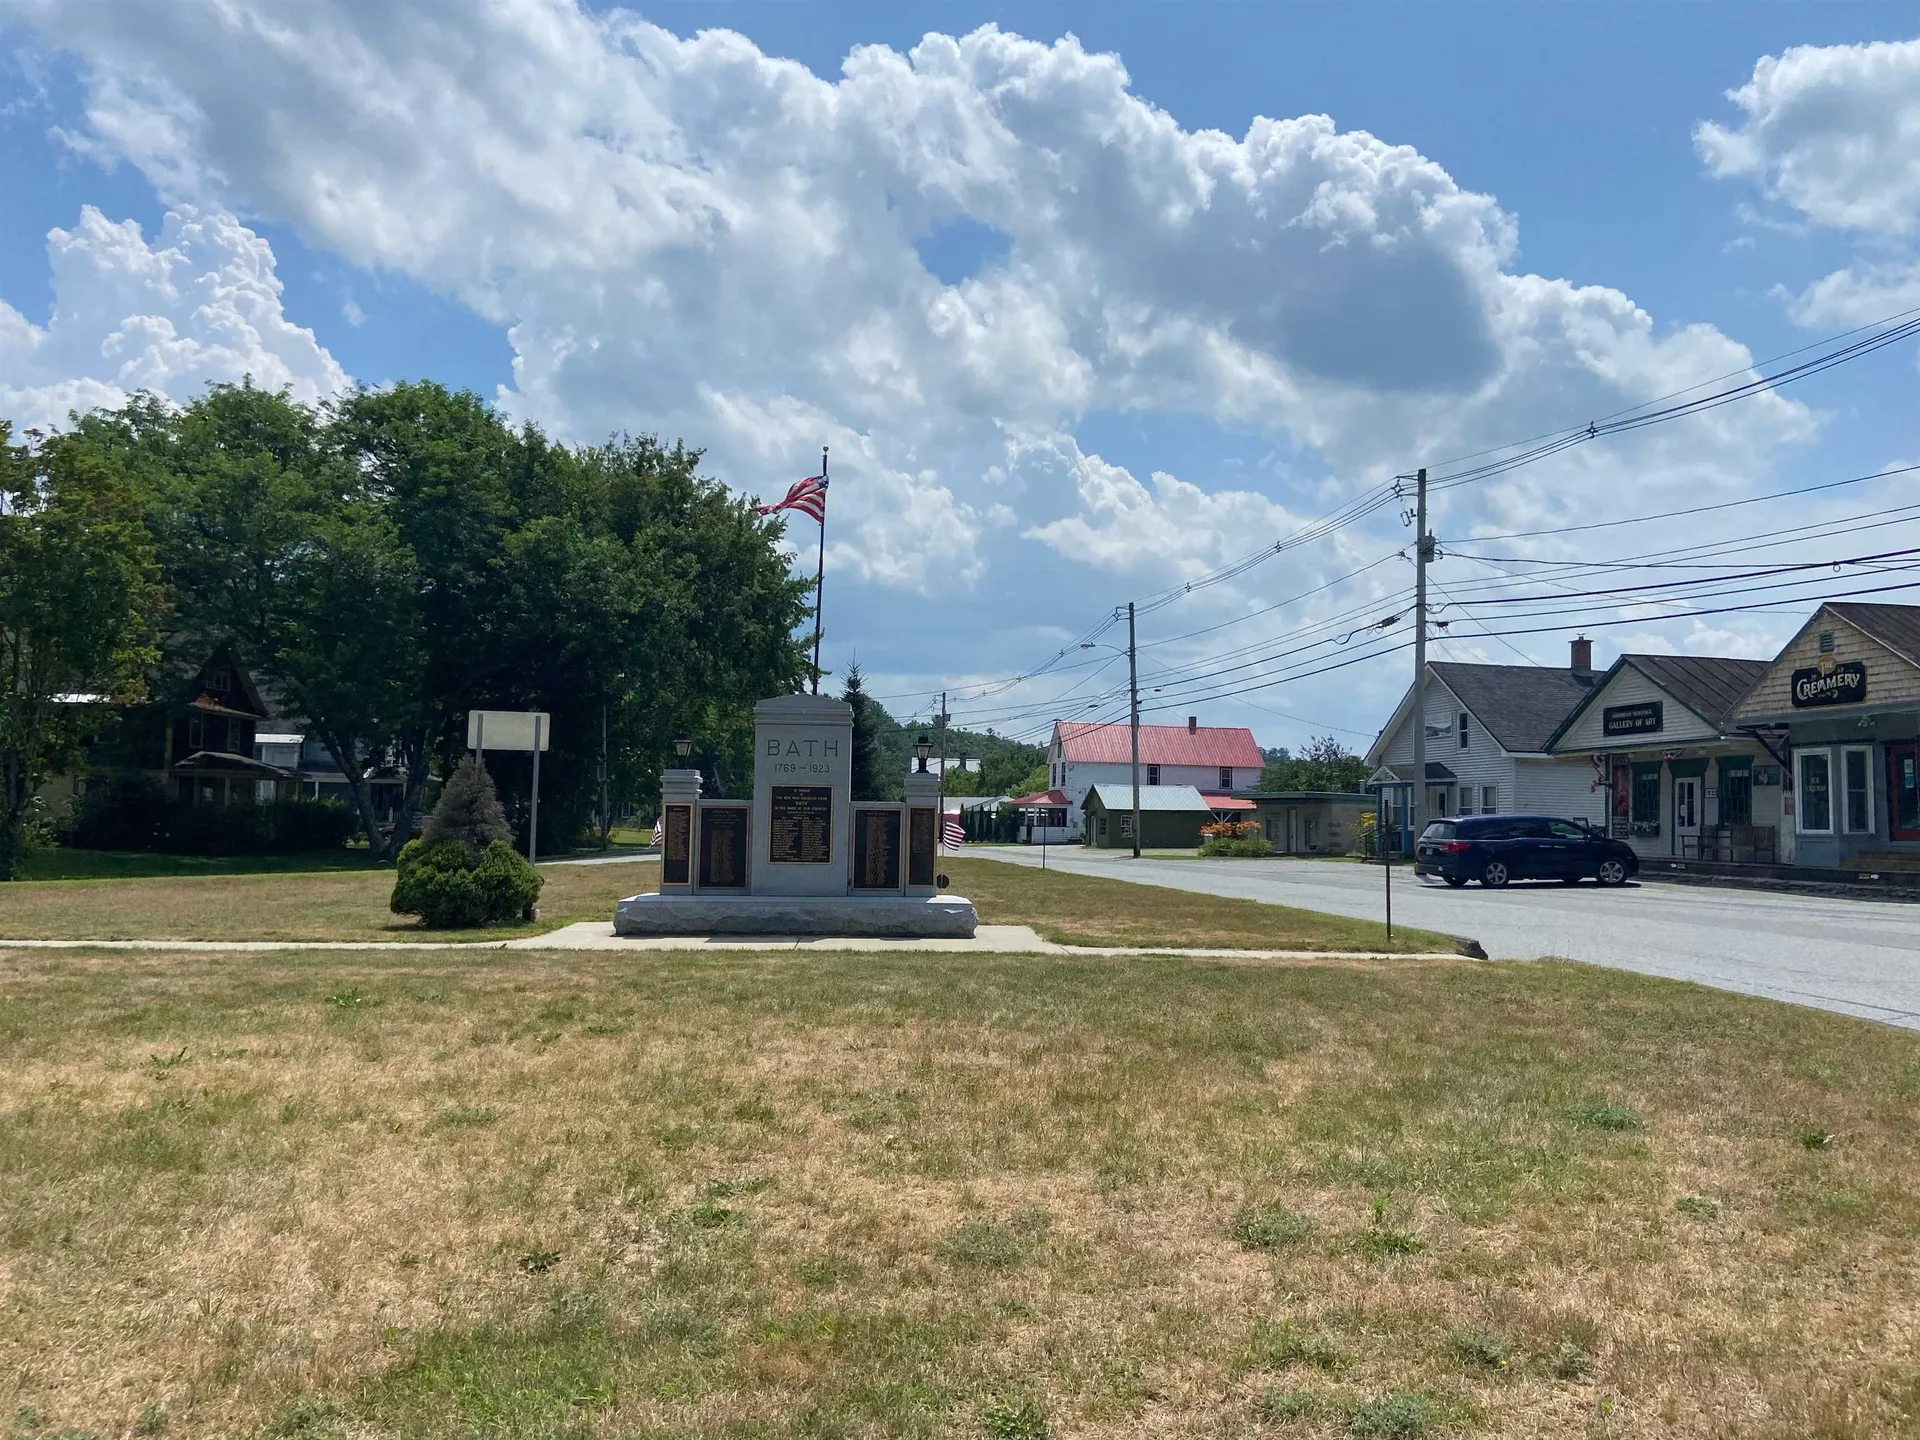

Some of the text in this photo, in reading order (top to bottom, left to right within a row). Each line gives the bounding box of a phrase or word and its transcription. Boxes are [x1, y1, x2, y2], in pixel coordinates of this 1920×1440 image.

[1820, 660, 1834, 677] THE
[1608, 717, 1657, 730] GALLERY OF ART
[766, 739, 839, 757] BATH
[774, 763, 796, 773] 1769
[809, 764, 830, 773] 1923
